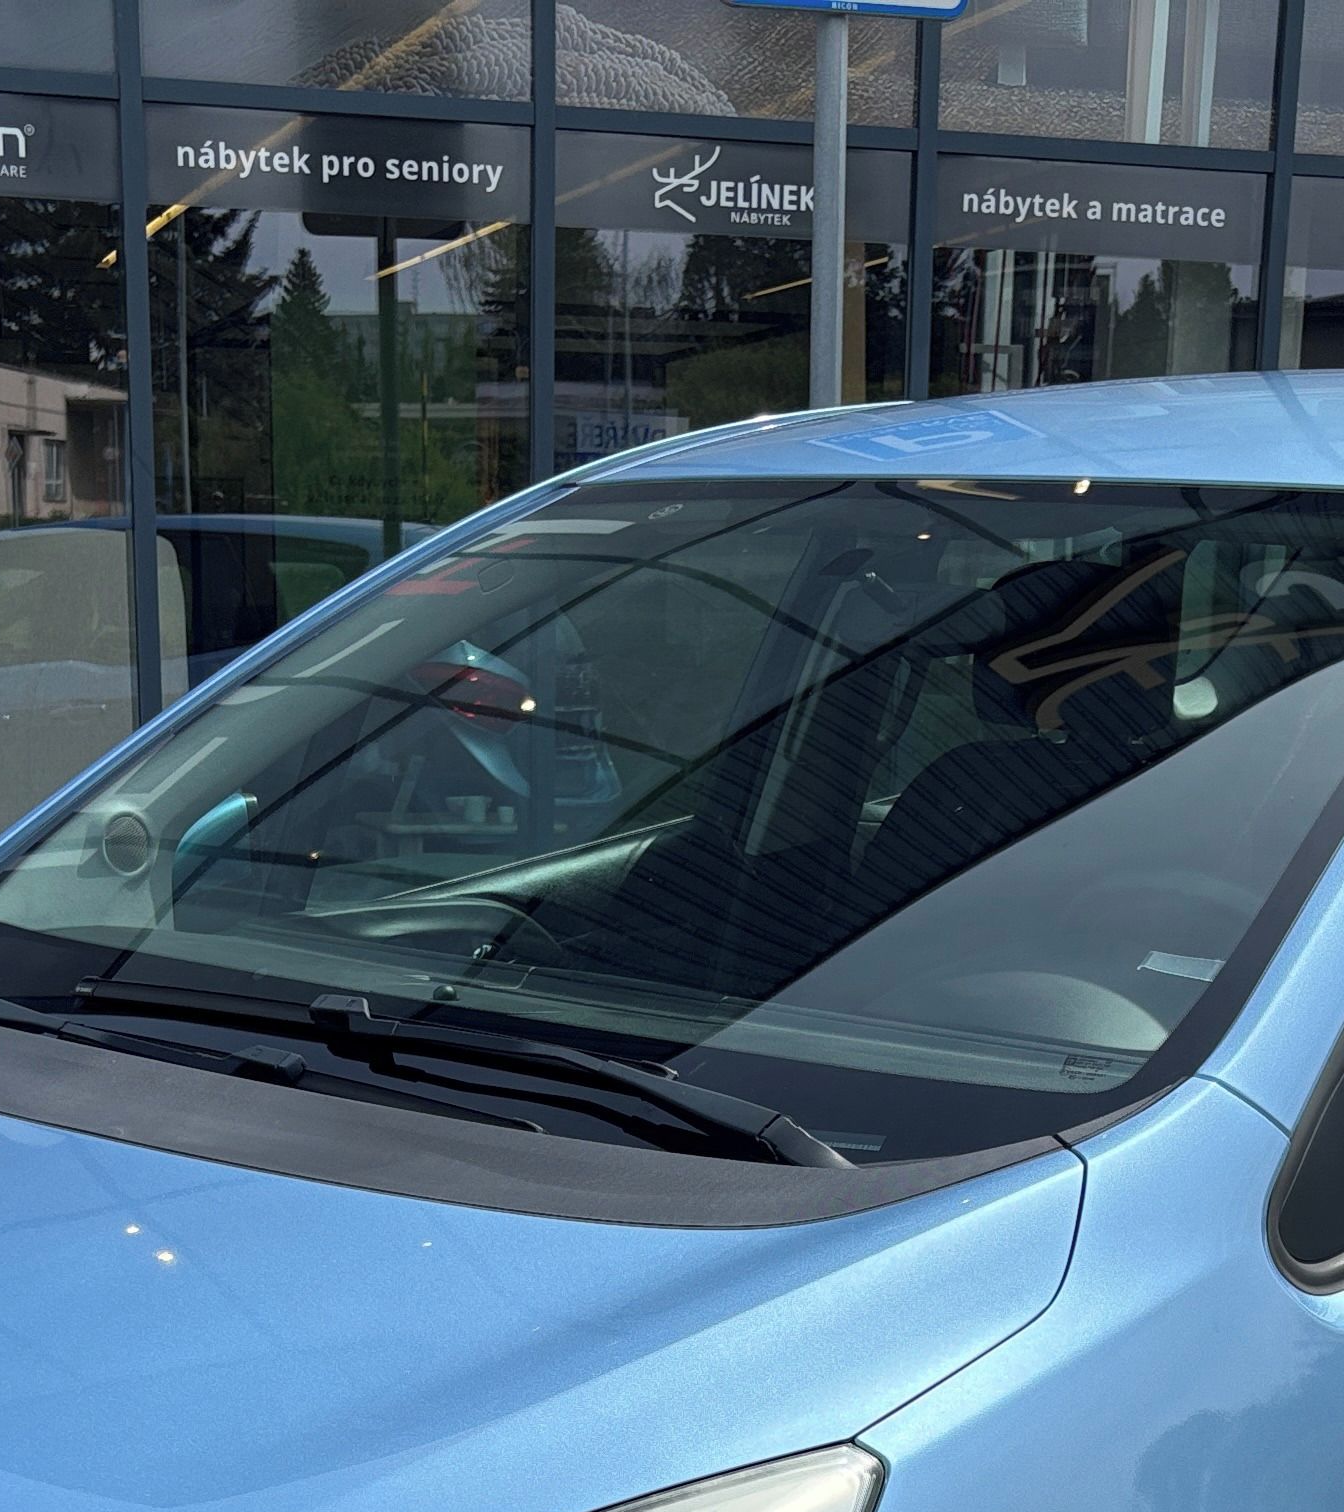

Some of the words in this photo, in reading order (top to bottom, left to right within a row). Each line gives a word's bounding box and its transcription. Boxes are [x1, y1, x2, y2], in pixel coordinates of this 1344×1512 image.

[177, 140, 311, 179] nábytek
[322, 154, 375, 184] pro
[386, 156, 504, 193] seniory
[700, 175, 815, 211] JELÍNEK
[962, 188, 1079, 222] nábytek
[1087, 201, 1102, 219] a
[1112, 201, 1226, 228] matrace
[730, 210, 791, 226] NÁBYTEK
